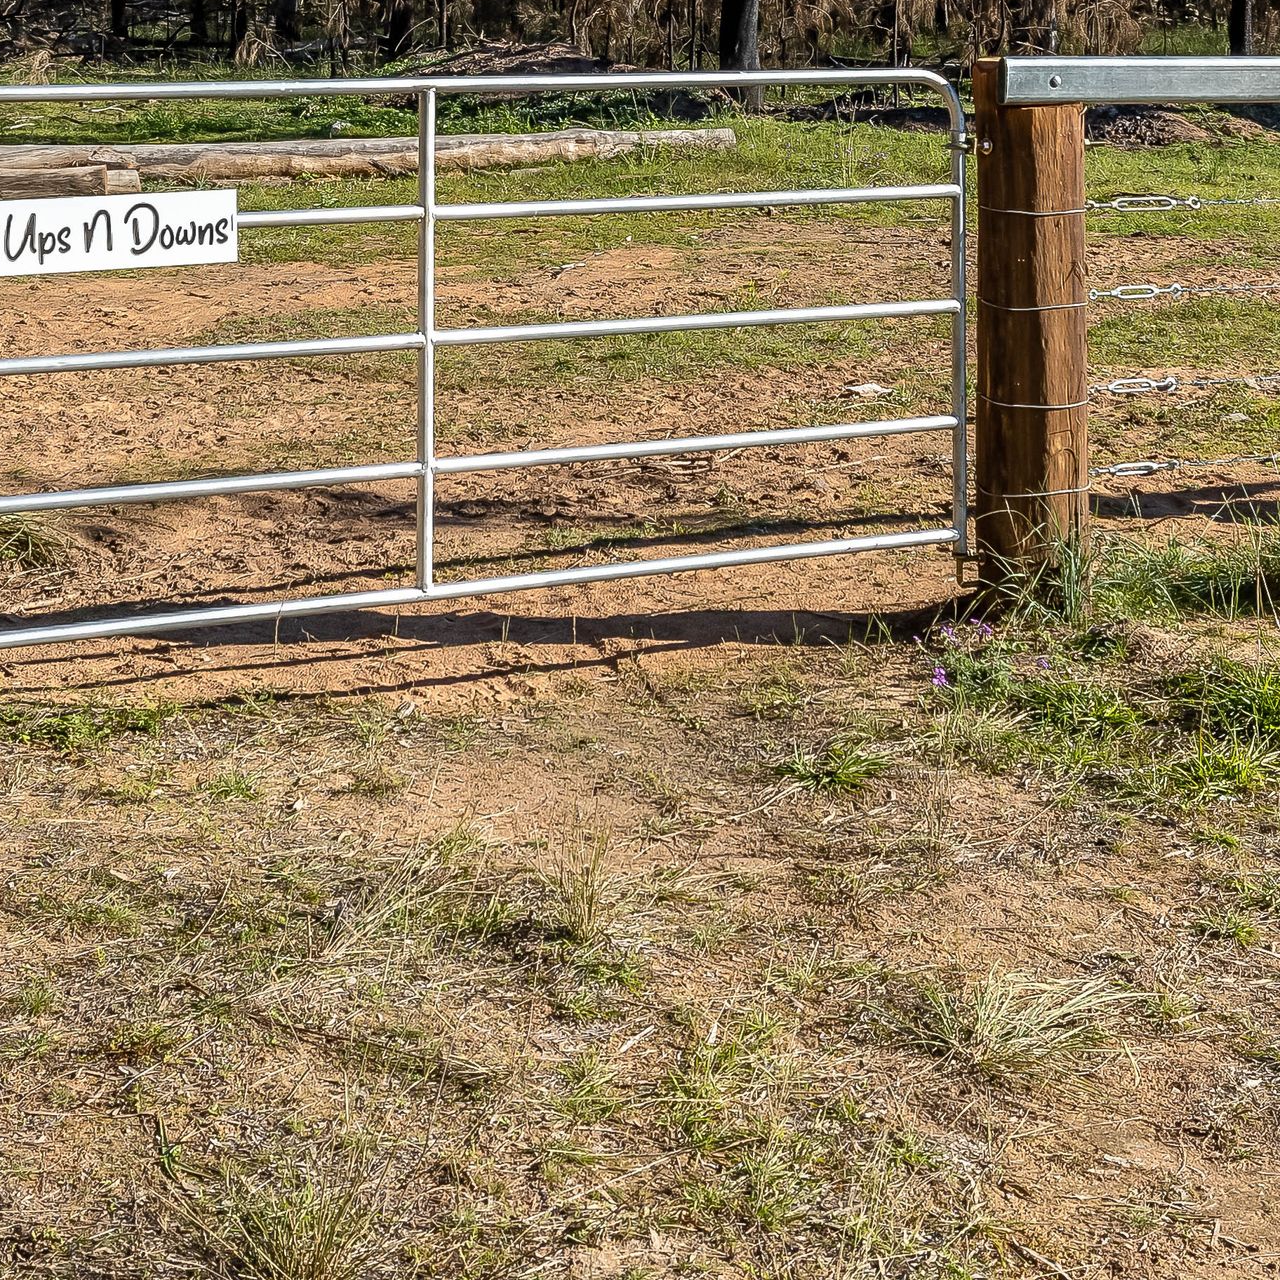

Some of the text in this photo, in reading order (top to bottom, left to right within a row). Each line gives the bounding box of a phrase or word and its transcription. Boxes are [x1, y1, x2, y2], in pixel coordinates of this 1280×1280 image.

[4, 202, 229, 265] Ups N Downs
